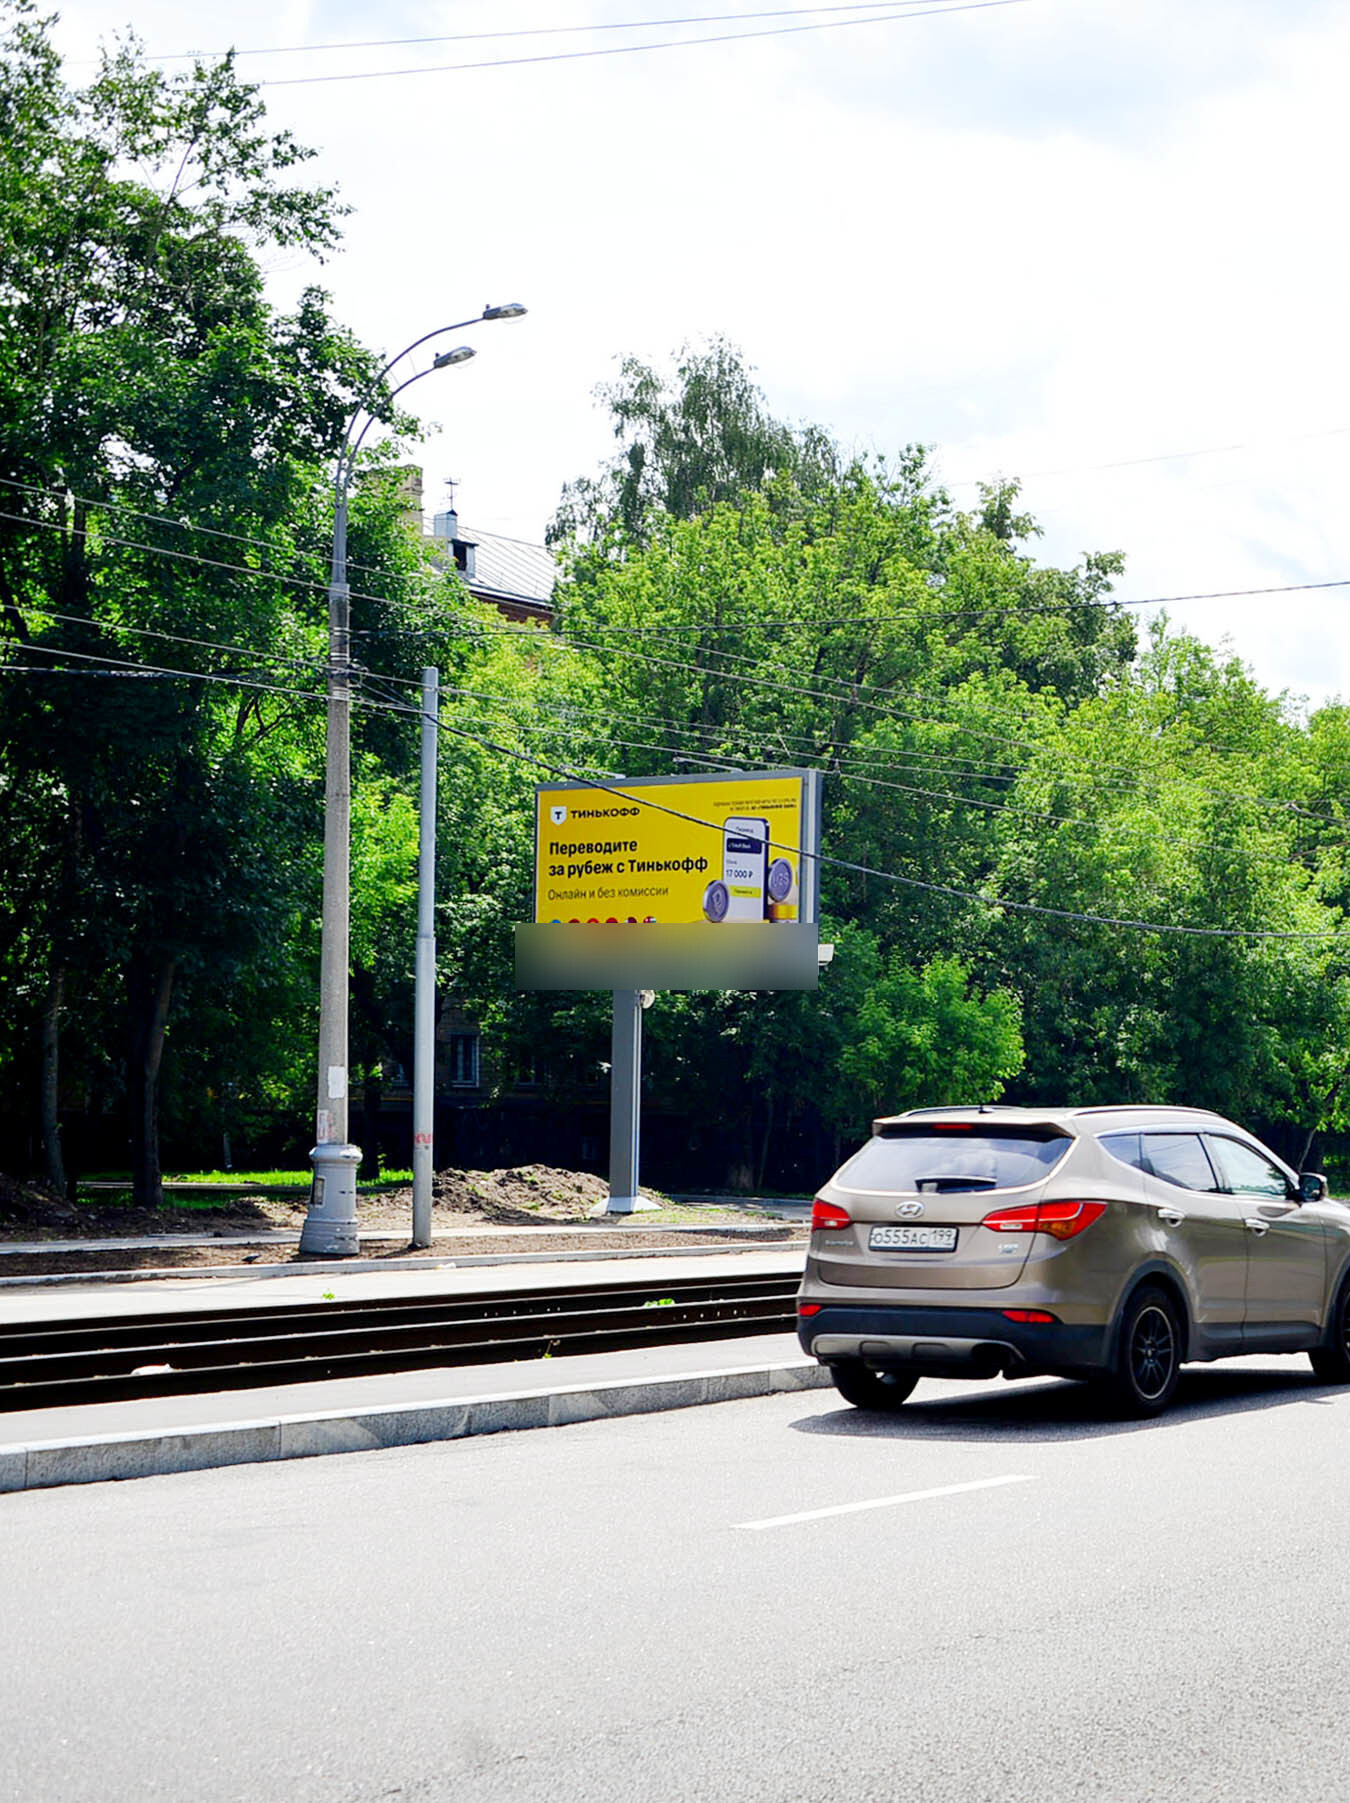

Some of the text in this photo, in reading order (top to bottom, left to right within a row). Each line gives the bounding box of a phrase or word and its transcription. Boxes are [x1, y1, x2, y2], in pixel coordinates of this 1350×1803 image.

[570, 807, 640, 819] ТИНЬКОФФ
[549, 841, 638, 857] Переводите
[549, 856, 708, 878] за рубеж с Тинькофф
[548, 886, 669, 901] Онлайн и без комиссии
